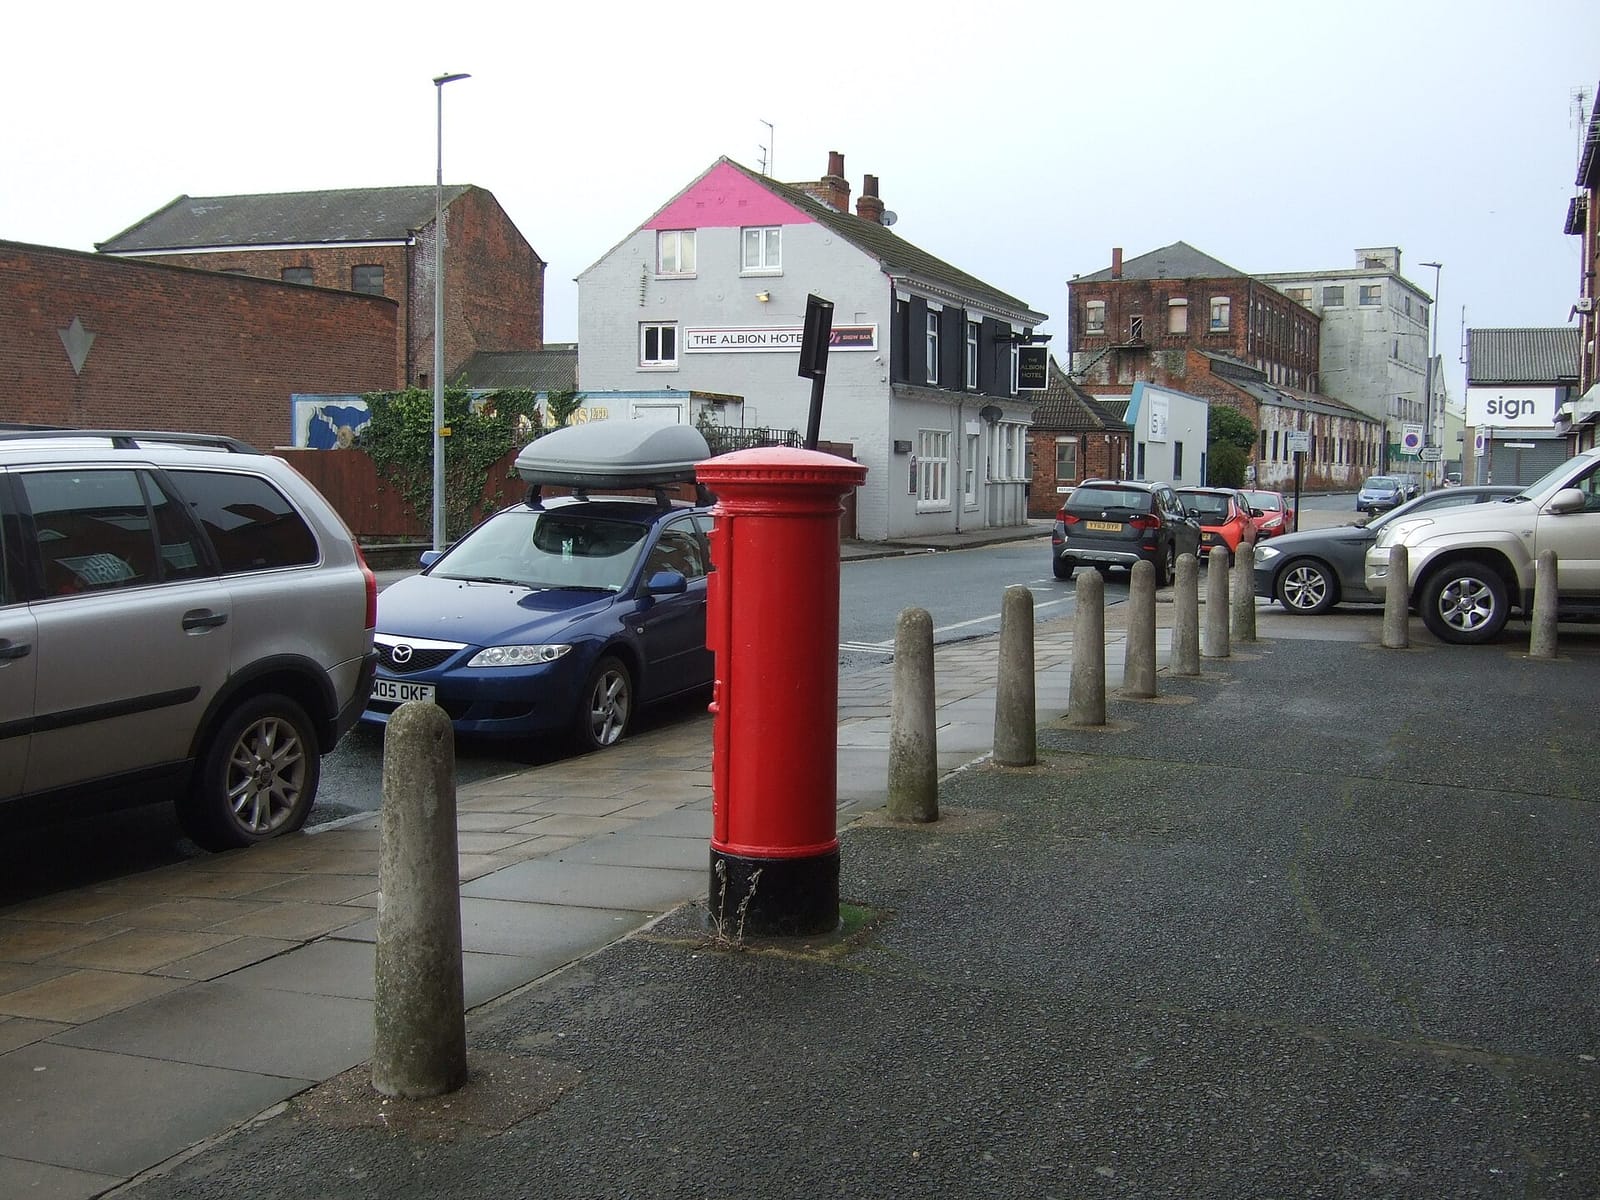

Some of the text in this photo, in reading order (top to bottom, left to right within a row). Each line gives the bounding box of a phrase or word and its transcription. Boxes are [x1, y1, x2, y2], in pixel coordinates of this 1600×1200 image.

[693, 332, 803, 345] THE ALBION HOTE
[1486, 395, 1535, 420] sign
[400, 685, 429, 701] OKF
